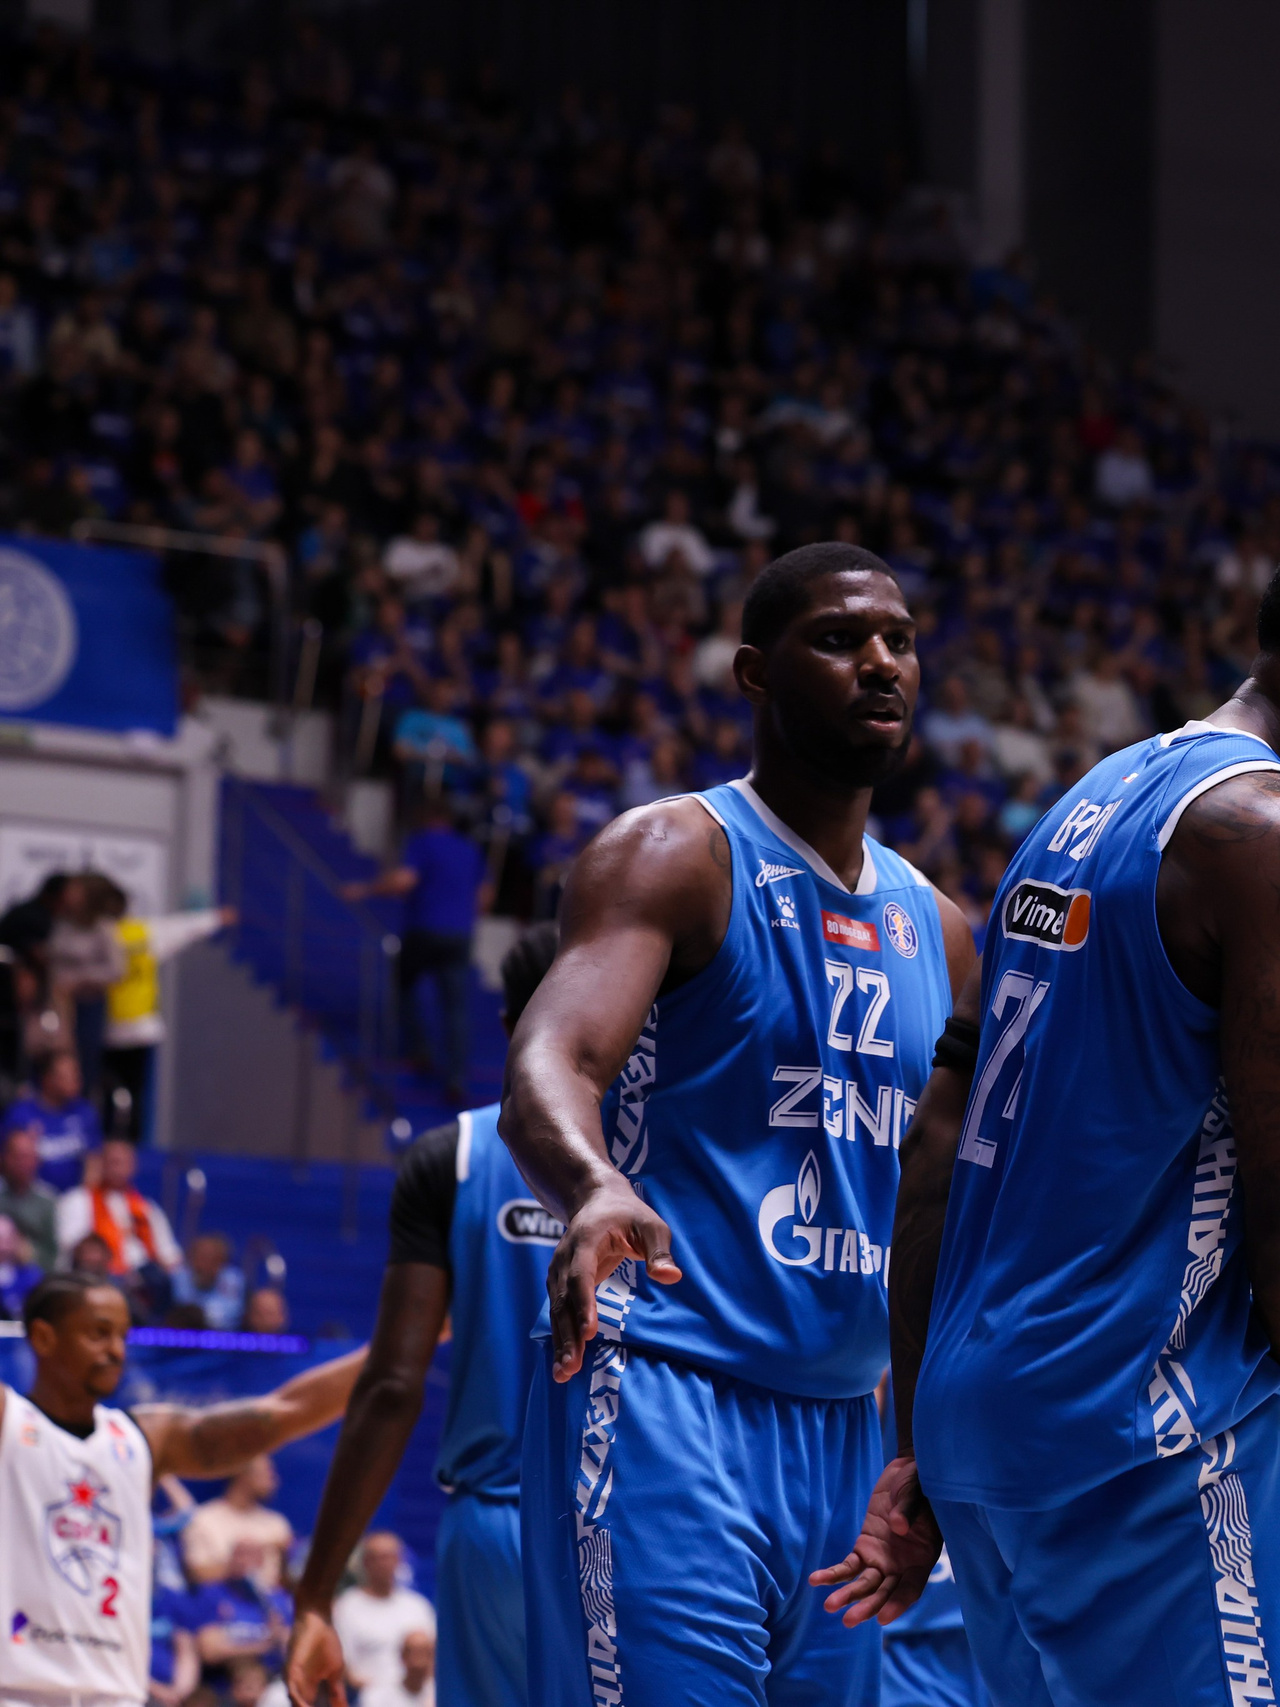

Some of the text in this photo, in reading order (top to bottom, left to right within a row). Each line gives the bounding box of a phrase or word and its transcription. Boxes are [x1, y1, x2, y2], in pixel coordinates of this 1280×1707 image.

[824, 957, 894, 1058] 22
[512, 1209, 565, 1237] Win
[101, 1576, 119, 1618] 2
